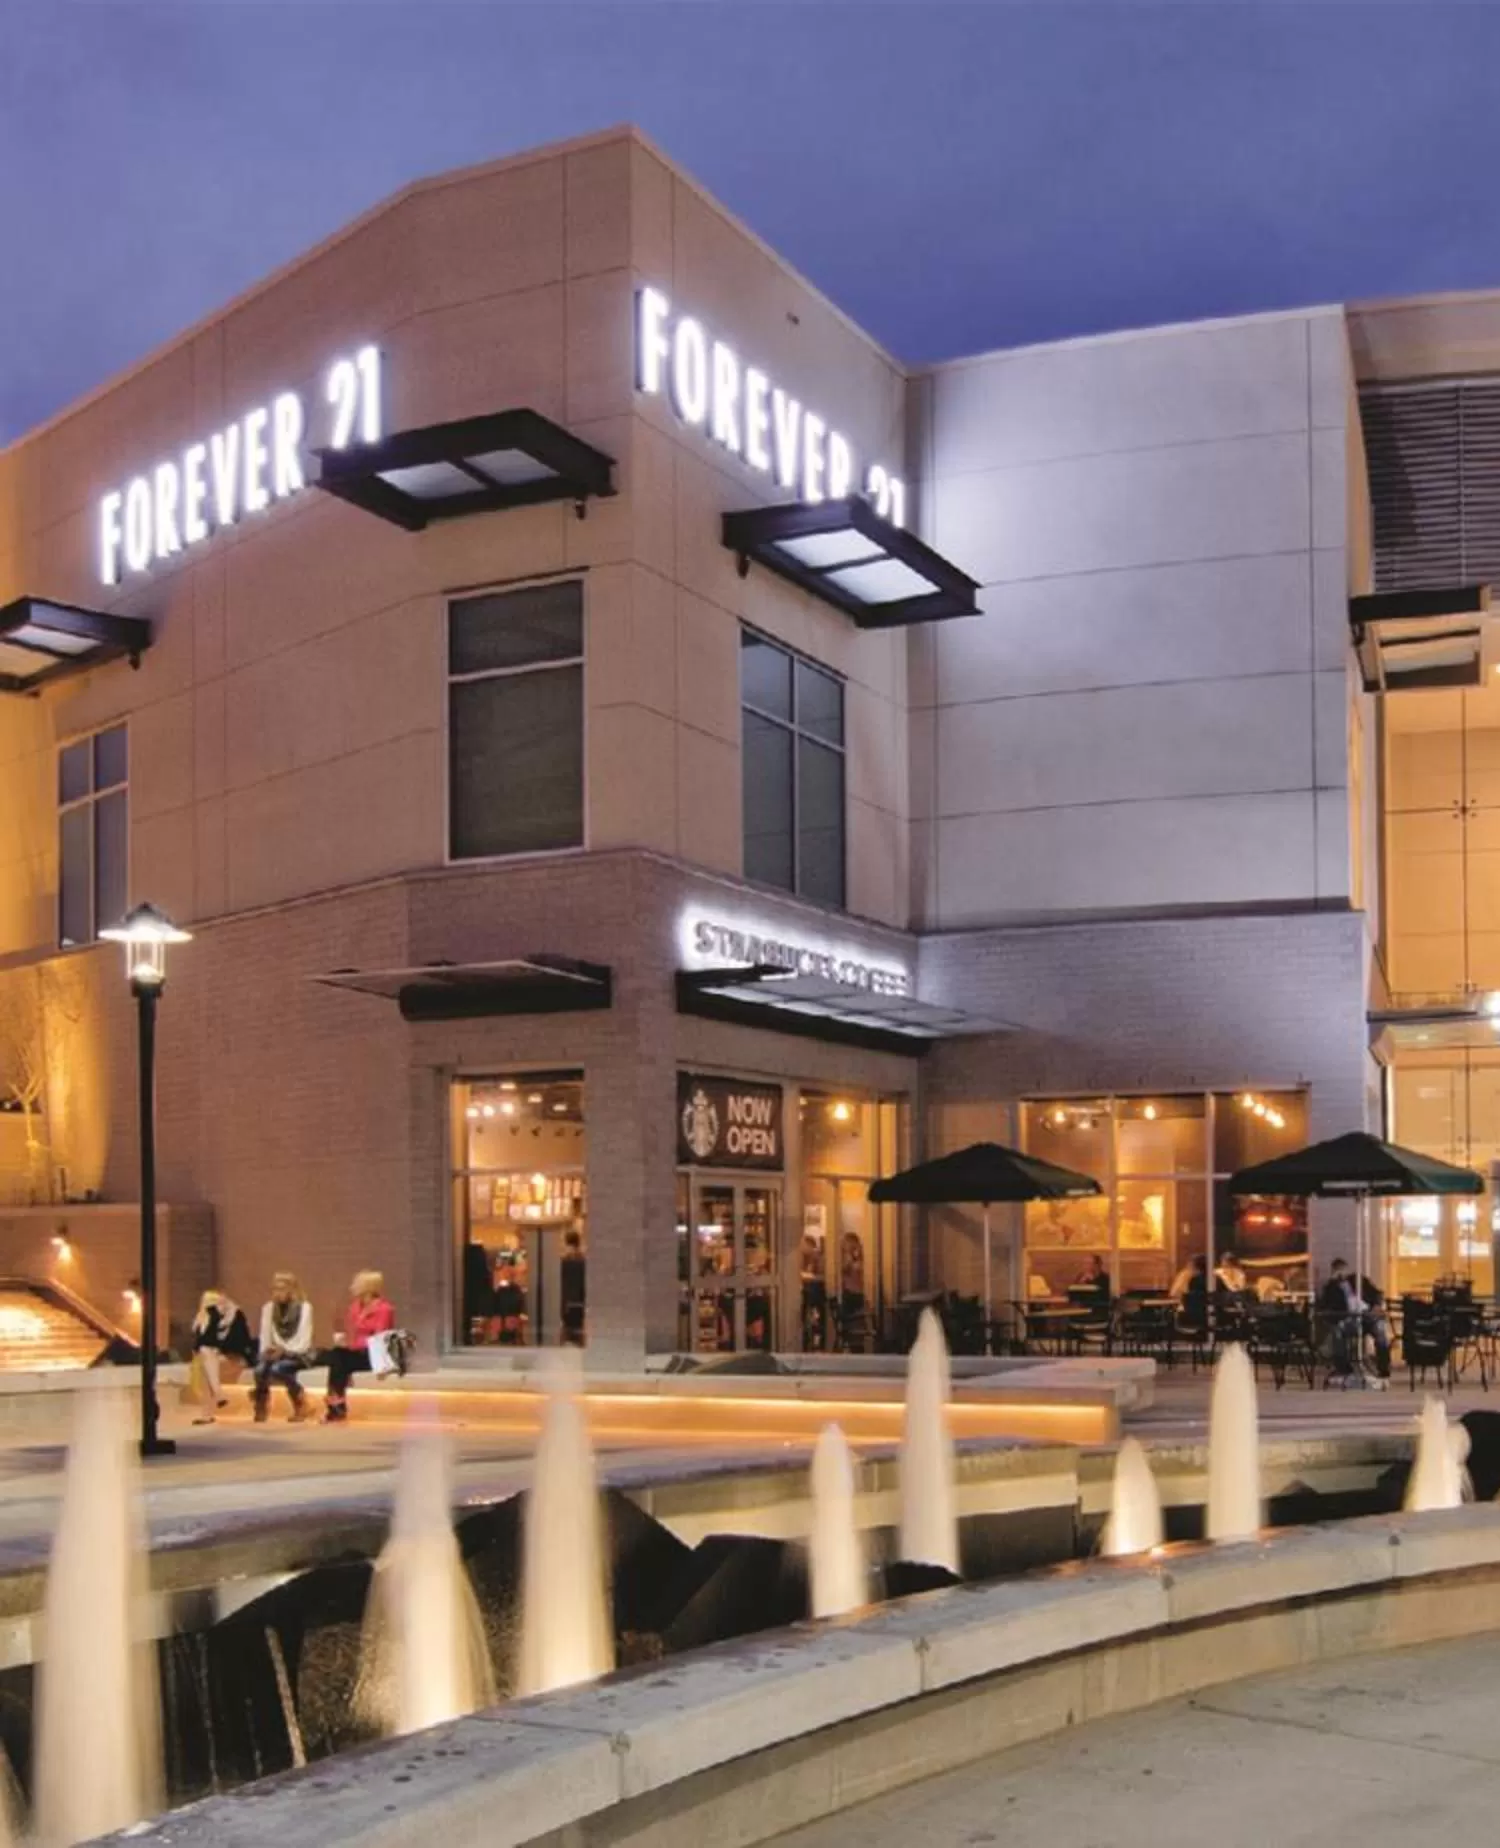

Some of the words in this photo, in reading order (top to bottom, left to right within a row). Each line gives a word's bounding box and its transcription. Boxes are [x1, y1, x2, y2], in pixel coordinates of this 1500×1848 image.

[636, 287, 851, 503] FOREVER
[101, 392, 305, 586] FOREVER
[327, 346, 381, 450] 21
[726, 1125, 776, 1157] OPEN
[727, 1094, 773, 1126] NOW
